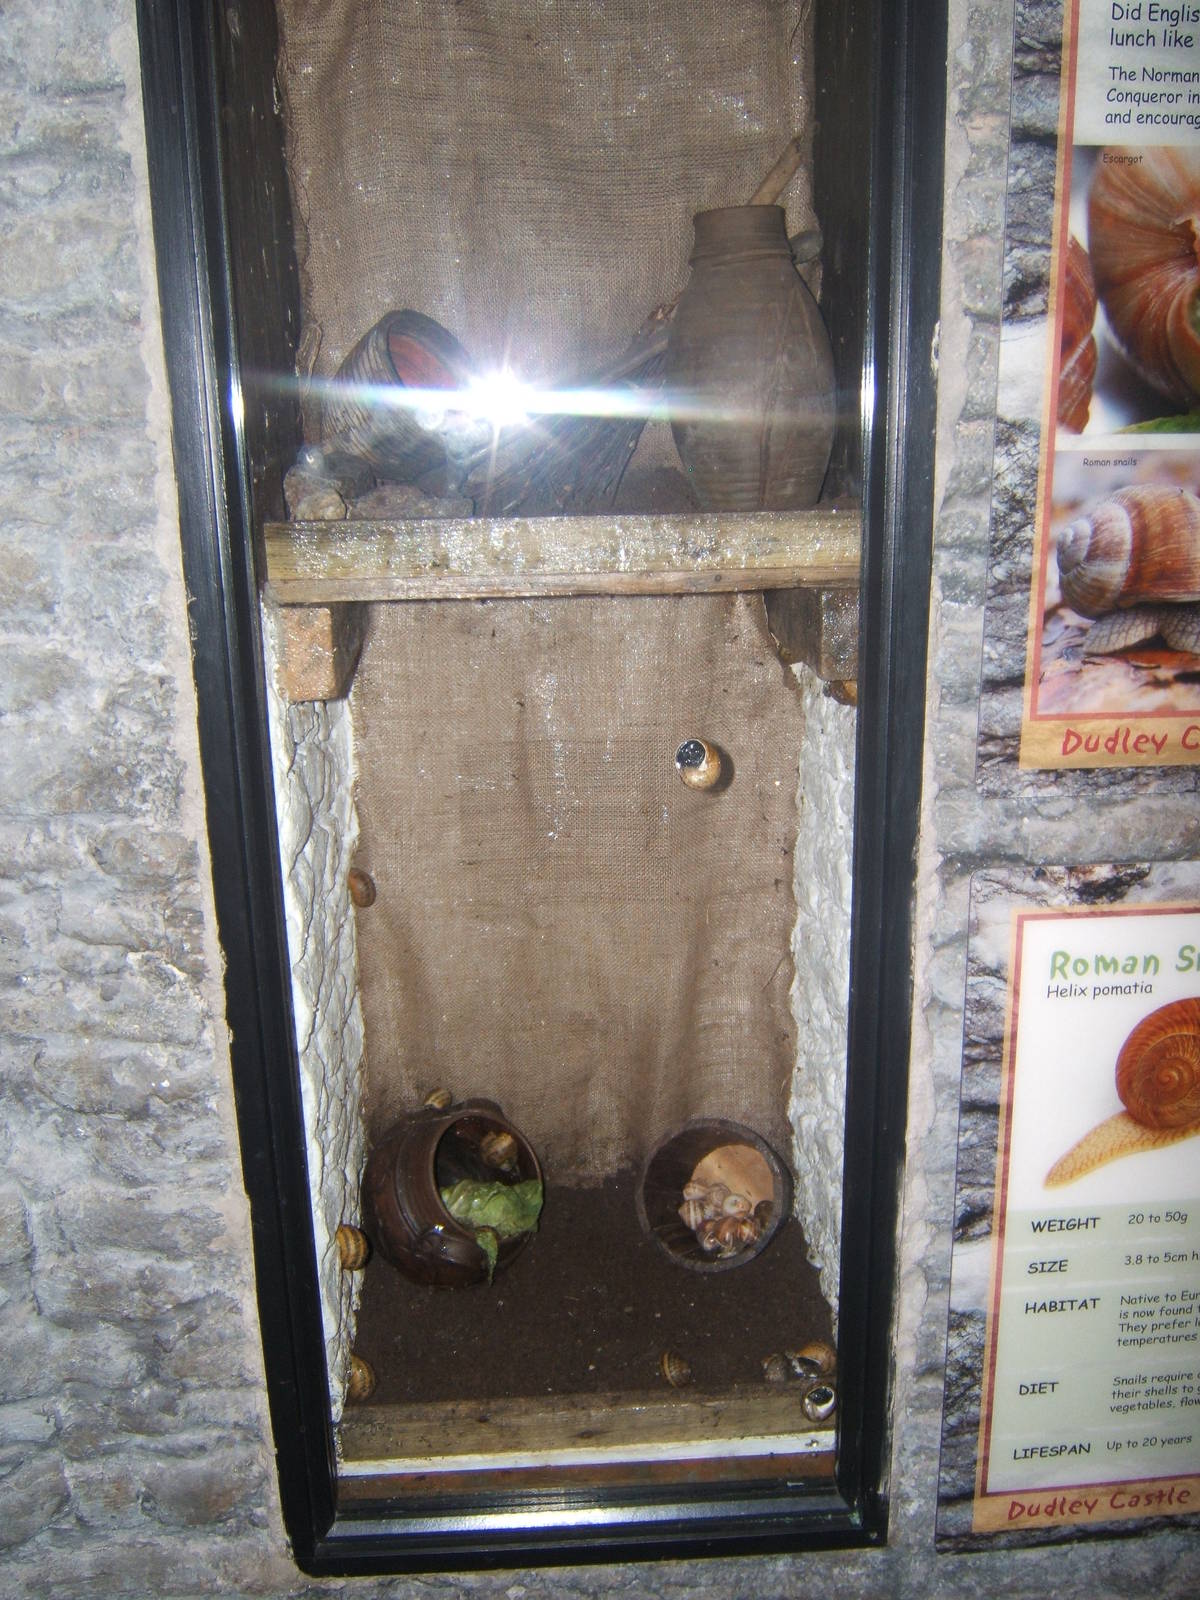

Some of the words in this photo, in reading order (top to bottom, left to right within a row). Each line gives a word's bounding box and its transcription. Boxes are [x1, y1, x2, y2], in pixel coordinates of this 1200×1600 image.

[1112, 2, 1141, 20] Did
[1149, 3, 1200, 27] Englis
[1110, 28, 1156, 47] lunch
[1163, 29, 1194, 48] like
[1109, 66, 1137, 81] The
[1142, 67, 1200, 83] Norman
[1106, 88, 1183, 106] Conqueror
[1105, 109, 1131, 124] and
[1136, 112, 1200, 130] encourag
[1103, 153, 1144, 166] Escargot
[1083, 458, 1111, 466] Roman
[1113, 457, 1137, 466] snails
[1062, 727, 1168, 756] Dudley
[1050, 950, 1160, 980] Roman
[1175, 944, 1200, 972] S
[1047, 983, 1088, 999] Helix
[1092, 981, 1153, 999] pomatia
[1031, 1217, 1101, 1233] WEIGHT
[1128, 1214, 1145, 1225] 20
[1148, 1213, 1161, 1224] to
[1165, 1211, 1188, 1224] 50g
[1027, 1259, 1069, 1274] SIZE
[1124, 1254, 1143, 1266] 3.8
[1147, 1253, 1160, 1264] to
[1163, 1252, 1188, 1263] 5cm
[1024, 1298, 1101, 1314] HABITAT
[1120, 1294, 1160, 1305] Native
[1164, 1293, 1177, 1302] to
[1119, 1310, 1129, 1319] is
[1132, 1309, 1155, 1319] now
[1160, 1304, 1194, 1317] found
[1118, 1322, 1148, 1334] They
[1151, 1319, 1192, 1334] prefer
[1117, 1332, 1198, 1348] temperatures
[1112, 1374, 1148, 1386] Snails
[1151, 1370, 1194, 1384] require
[1019, 1381, 1060, 1396] DIET
[1112, 1389, 1142, 1399] their
[1144, 1385, 1178, 1398] shells
[1182, 1385, 1194, 1394] to
[1106, 1441, 1122, 1452] Up
[1127, 1440, 1138, 1449] to
[1142, 1436, 1158, 1447] 20
[1160, 1435, 1193, 1448] years
[1013, 1443, 1092, 1461] LIFESPAN
[1008, 1497, 1099, 1521] Dudley
[1109, 1487, 1191, 1509] Castle
